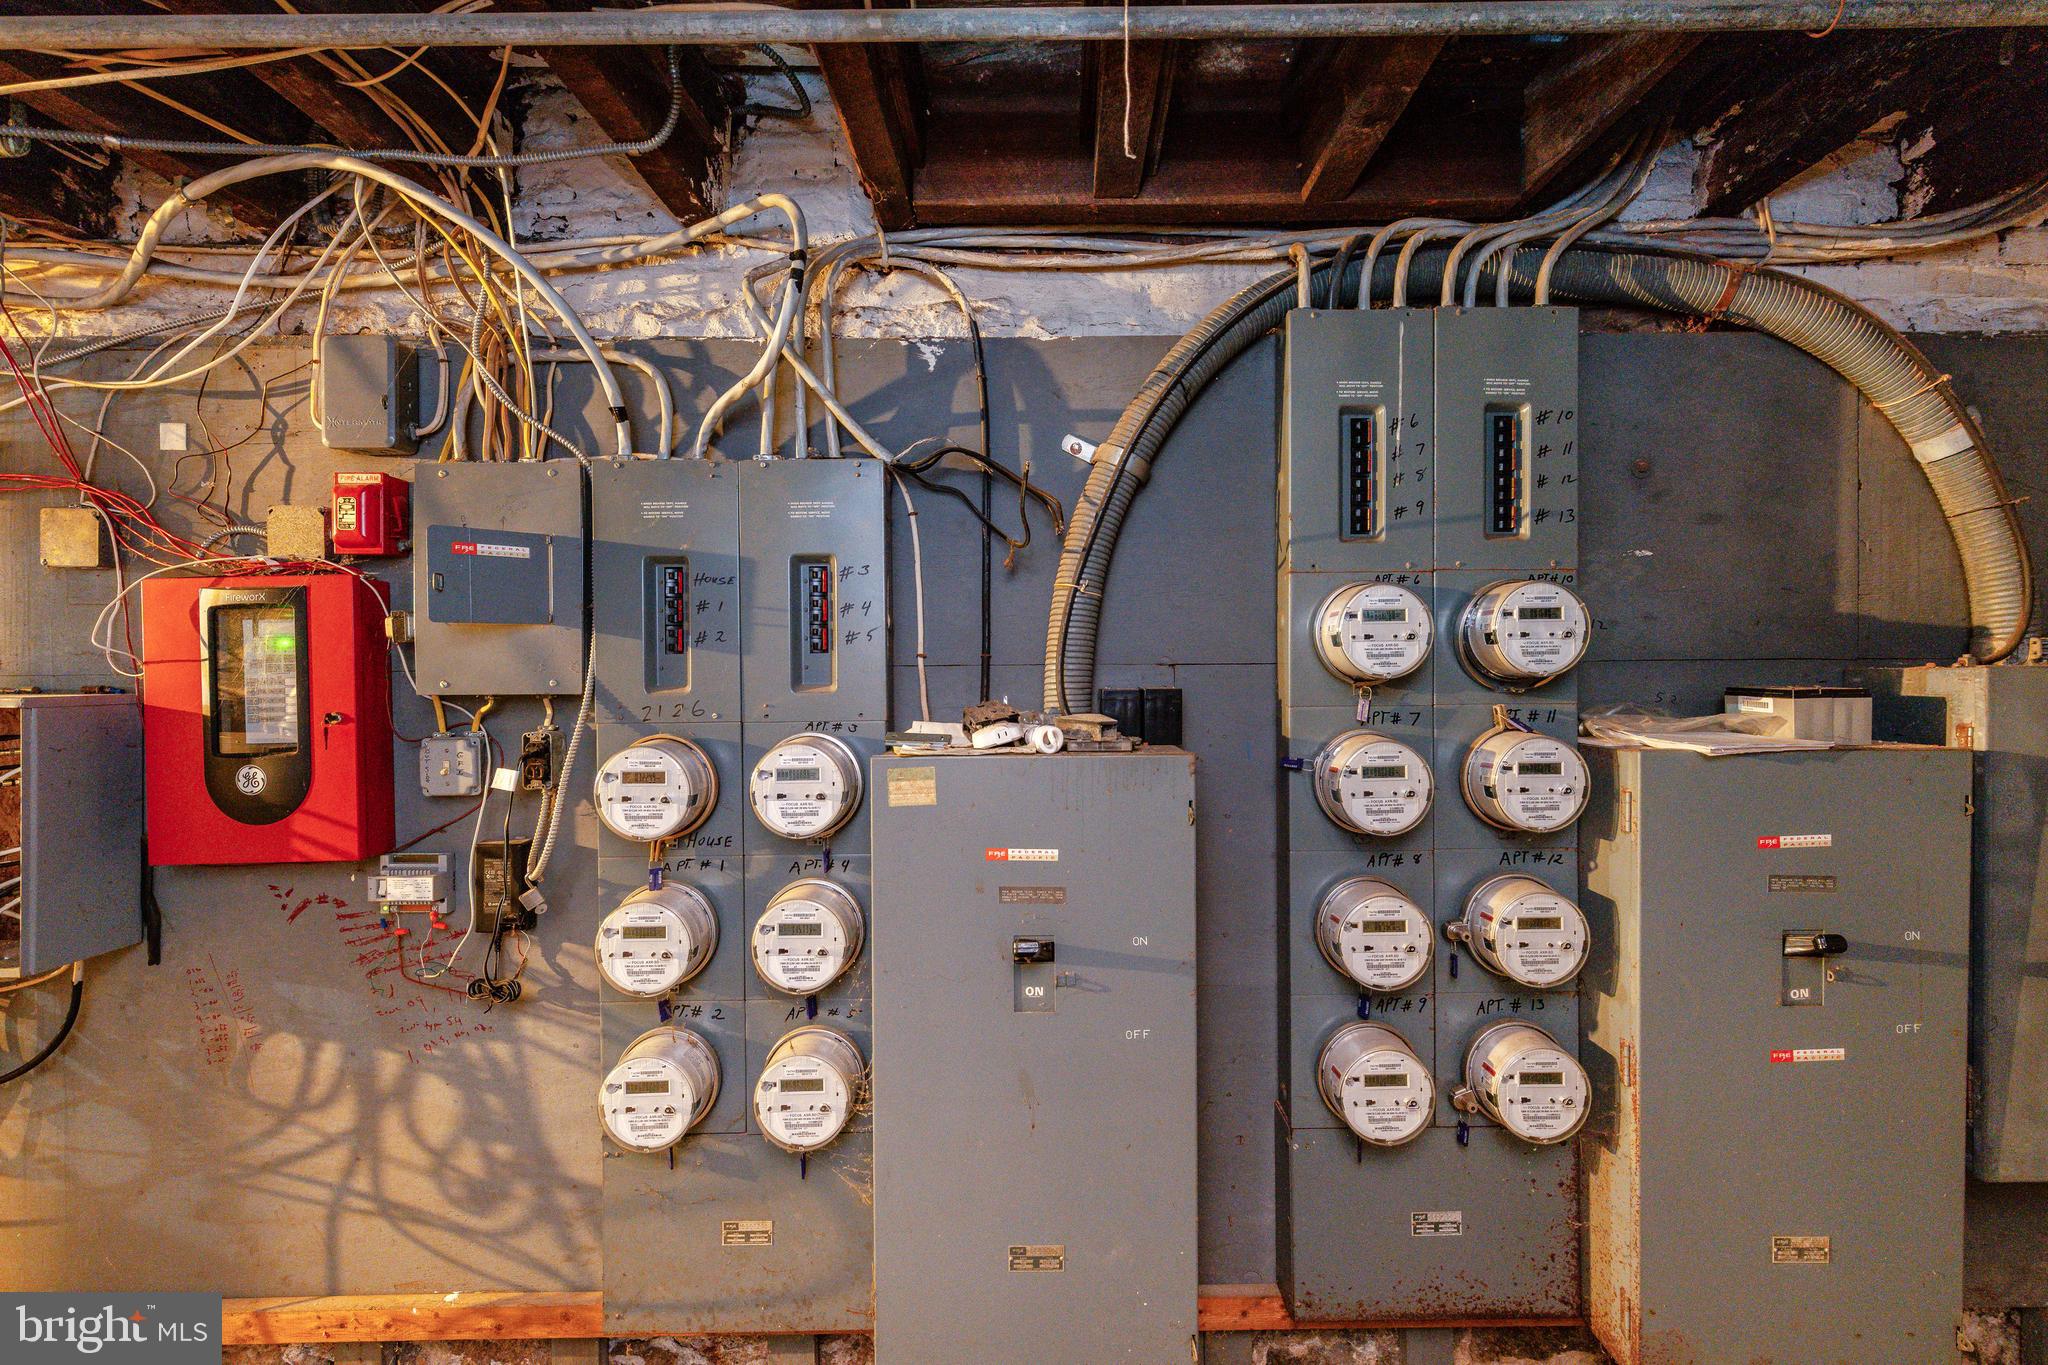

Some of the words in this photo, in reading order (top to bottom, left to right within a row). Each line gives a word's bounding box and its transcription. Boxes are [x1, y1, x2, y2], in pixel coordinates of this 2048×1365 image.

[1536, 409, 1553, 425] #
[1557, 410, 1574, 423] 10
[1389, 417, 1405, 435] #
[1410, 414, 1419, 428] 6
[1392, 444, 1404, 462] #
[1416, 443, 1425, 456] 7
[1537, 443, 1552, 459] #
[1562, 441, 1573, 455] 11
[1393, 472, 1405, 488] #
[1416, 467, 1427, 482] 8
[1537, 474, 1549, 488] #
[1561, 475, 1577, 485] 12
[1394, 506, 1408, 519] #
[1416, 500, 1425, 516] 9
[1535, 509, 1550, 525] #
[1558, 508, 1576, 523] 13
[694, 571, 736, 586] HOUSE
[839, 567, 855, 580] #
[858, 564, 871, 576] 3
[1414, 574, 1421, 585] 6
[1561, 575, 1574, 585] 10
[696, 599, 710, 612] #
[718, 601, 724, 612] 1
[840, 602, 855, 617] #
[858, 600, 872, 616] 4
[694, 631, 708, 644] #
[715, 630, 728, 643] 2
[845, 630, 858, 644] #
[867, 626, 881, 642] 5
[1409, 711, 1421, 726] 7
[1527, 710, 1540, 722] #
[1546, 709, 1557, 723] 11
[831, 721, 843, 732] #
[687, 831, 732, 848] HOUSE
[1413, 853, 1423, 865] 8
[1499, 850, 1530, 866] APT
[1531, 850, 1546, 864] #
[1547, 853, 1564, 865] 12
[700, 859, 712, 871] #
[720, 859, 725, 872] 1
[841, 859, 850, 873] 4
[1132, 935, 1149, 947] ON
[1904, 930, 1921, 941] ON
[1025, 986, 1044, 996] ON
[1790, 988, 1810, 1000] ON
[1419, 997, 1428, 1013] 9
[1476, 998, 1506, 1016] APT.
[1509, 997, 1522, 1014] #
[1531, 998, 1545, 1011] 13
[711, 1008, 726, 1020] 2
[1125, 1029, 1151, 1041] OFF
[1896, 1023, 1922, 1034] OFF
